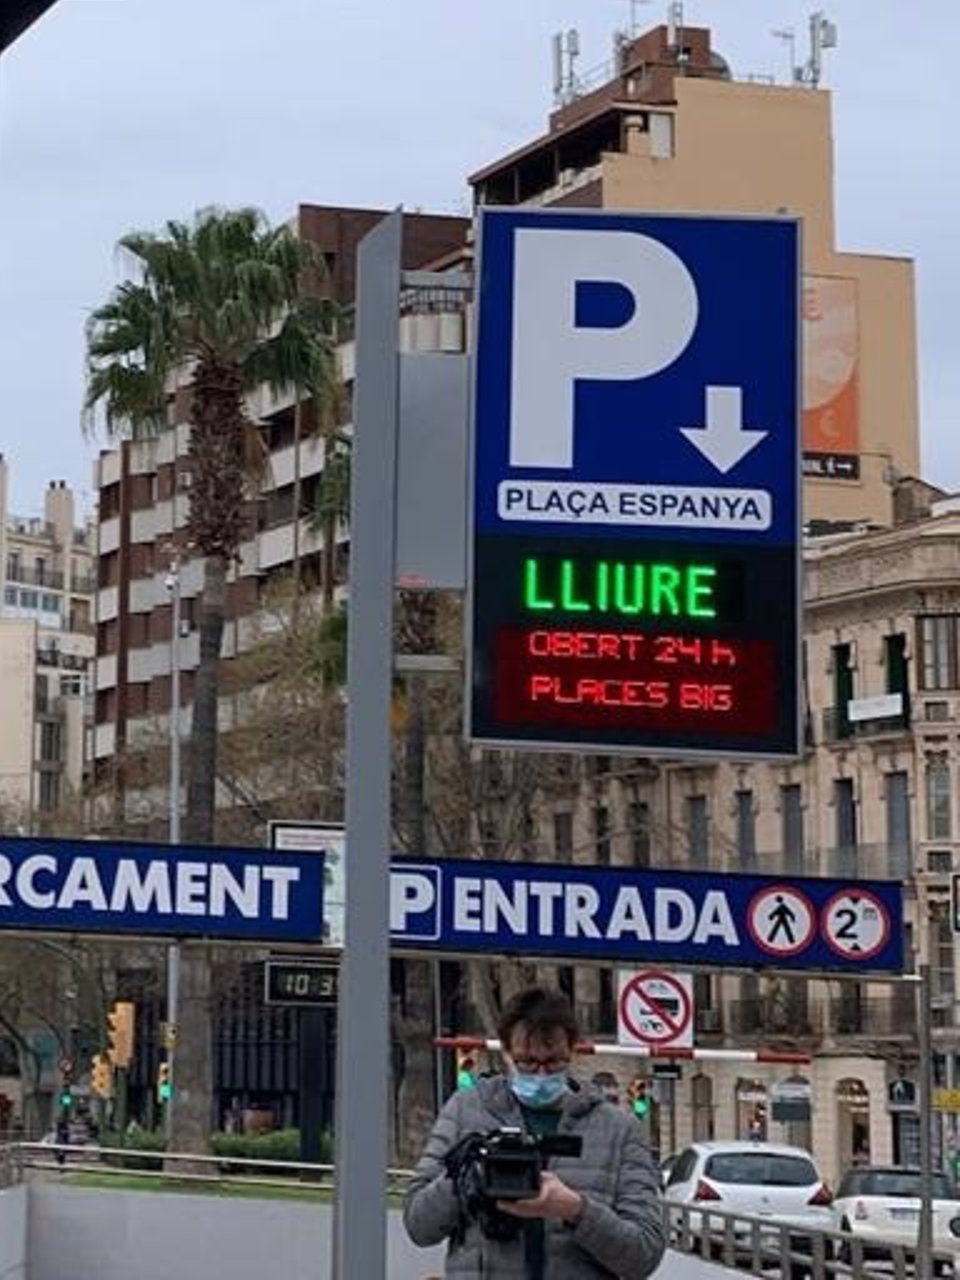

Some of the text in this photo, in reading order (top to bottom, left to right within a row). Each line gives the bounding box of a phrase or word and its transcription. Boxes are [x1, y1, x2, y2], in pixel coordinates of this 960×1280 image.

[509, 227, 700, 469] P
[506, 488, 762, 521] PLAÇA ESPANYA
[526, 559, 717, 618] LLIURE
[528, 630, 644, 660] OBERT
[654, 636, 701, 664] 24
[531, 675, 669, 708] PLACES
[390, 873, 740, 947] P ENTRADA
